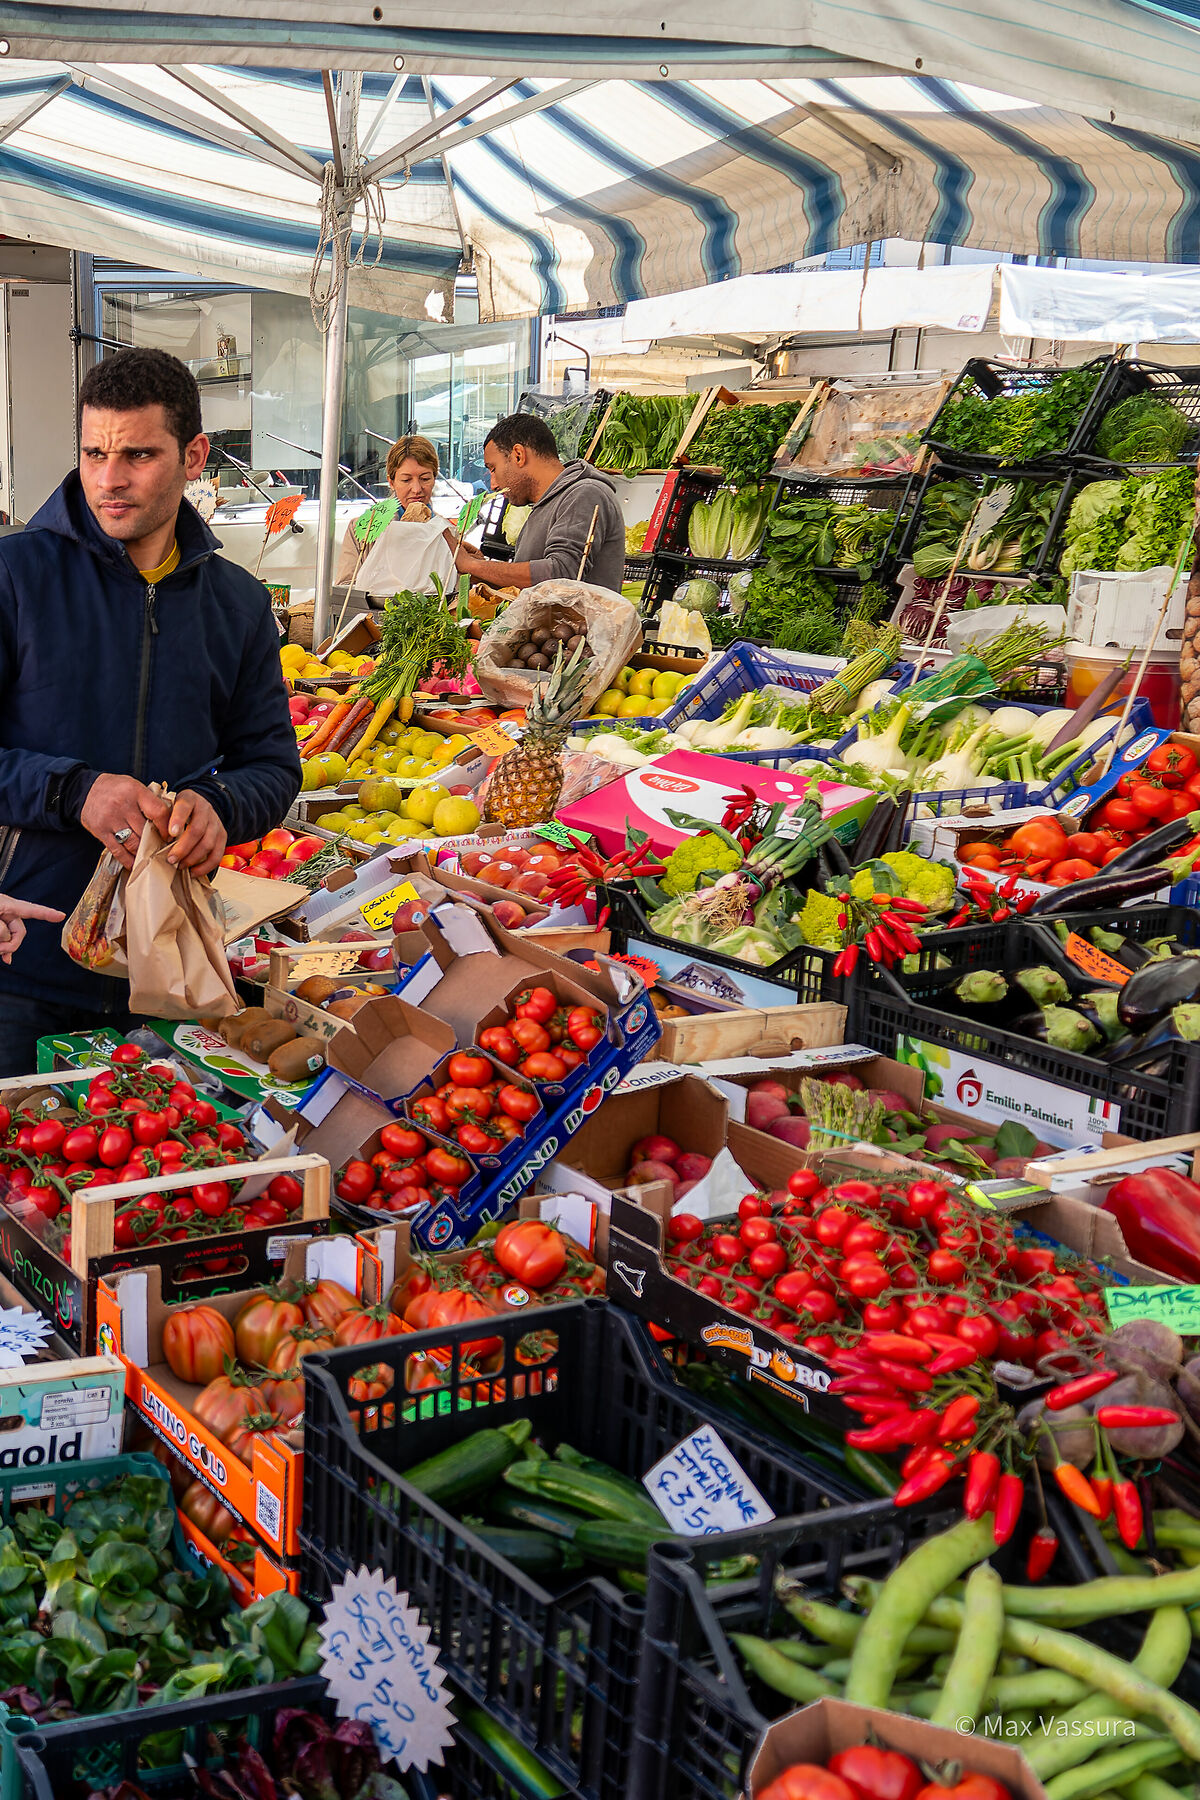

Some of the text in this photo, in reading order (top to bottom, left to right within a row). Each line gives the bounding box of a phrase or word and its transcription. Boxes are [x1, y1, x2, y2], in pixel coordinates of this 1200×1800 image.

[986, 1089, 1022, 1112] Emilio
[1024, 1102, 1074, 1131] Palmieri
[1088, 1116, 1108, 1128] 100%
[480, 1136, 558, 1225] LATINO
[141, 1383, 228, 1487] LATINO GOLD
[376, 1590, 439, 1703] CICORINO
